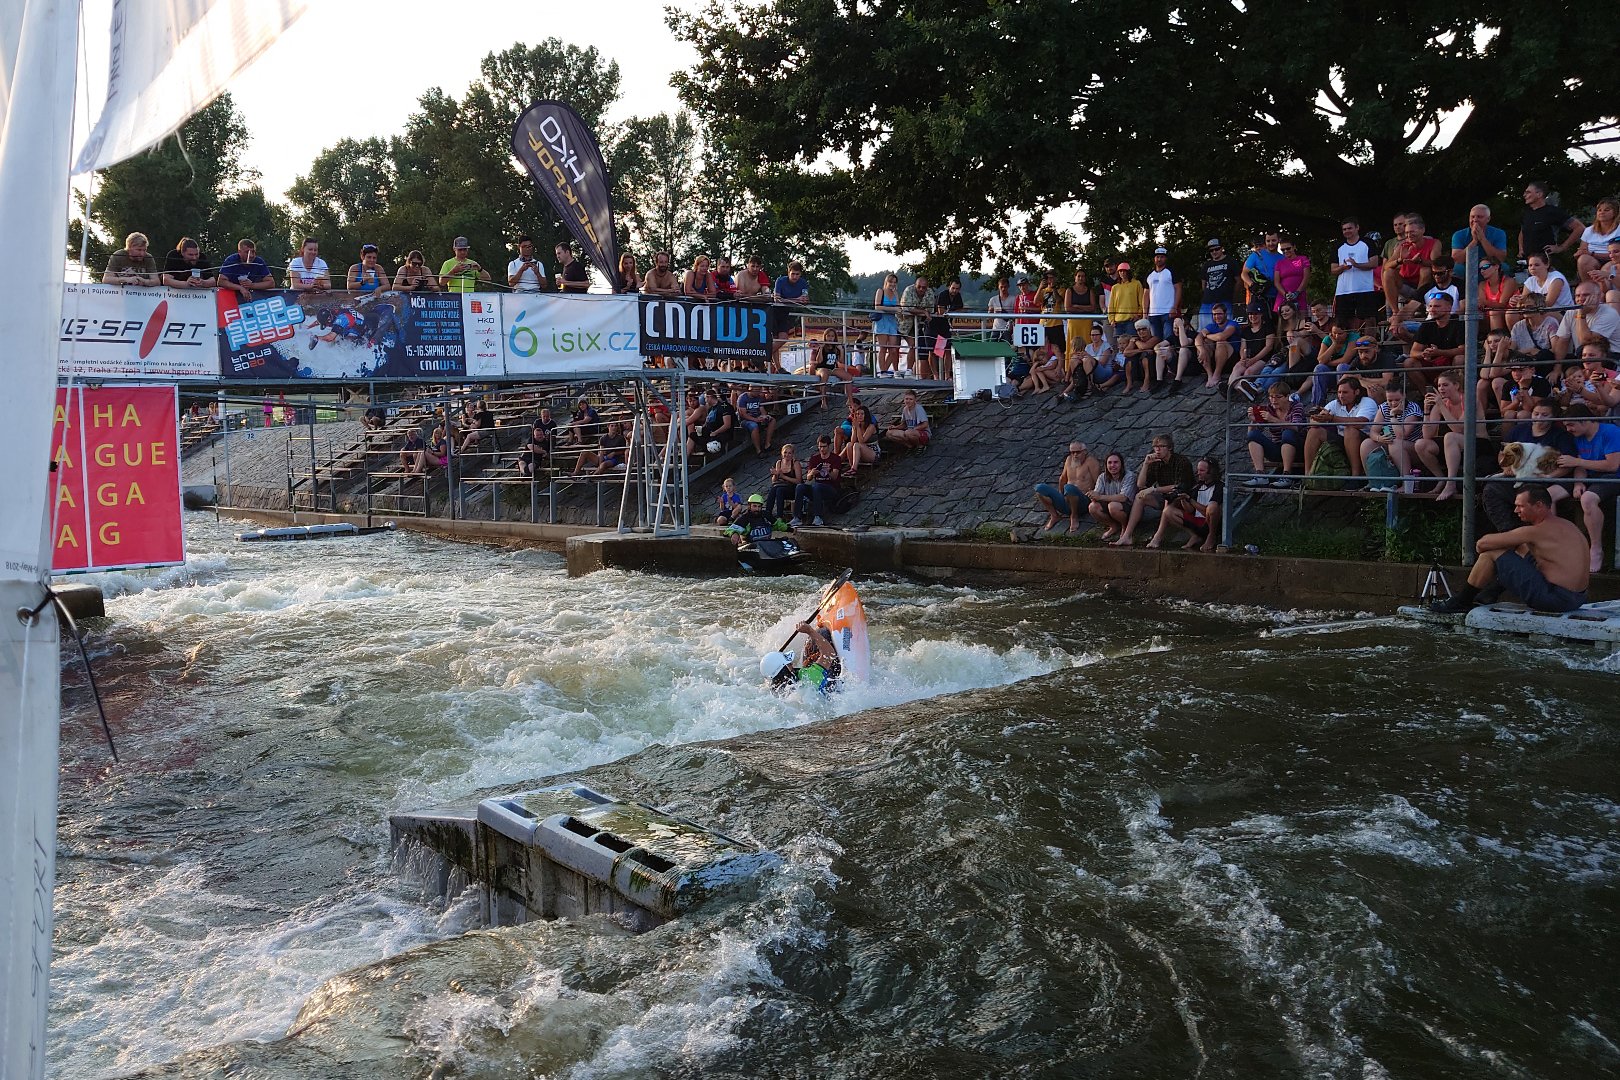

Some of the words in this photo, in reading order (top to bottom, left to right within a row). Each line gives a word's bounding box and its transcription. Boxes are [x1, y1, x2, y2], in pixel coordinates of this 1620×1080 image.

[411, 296, 426, 309] MČR
[552, 327, 638, 353] isix.cz
[1021, 326, 1038, 345] 65
[445, 345, 463, 357] 2020
[661, 343, 687, 352] NÁRODNÍ
[688, 344, 711, 354] ASOCIACE
[713, 347, 748, 356] WHITEWATER
[748, 349, 767, 357] RODEA
[88, 366, 111, 374] Praha
[233, 358, 266, 372] 2020
[93, 403, 142, 428] HA
[790, 404, 799, 414] 66
[94, 442, 166, 467] GUE
[96, 482, 145, 507] GA
[98, 521, 120, 546] G
